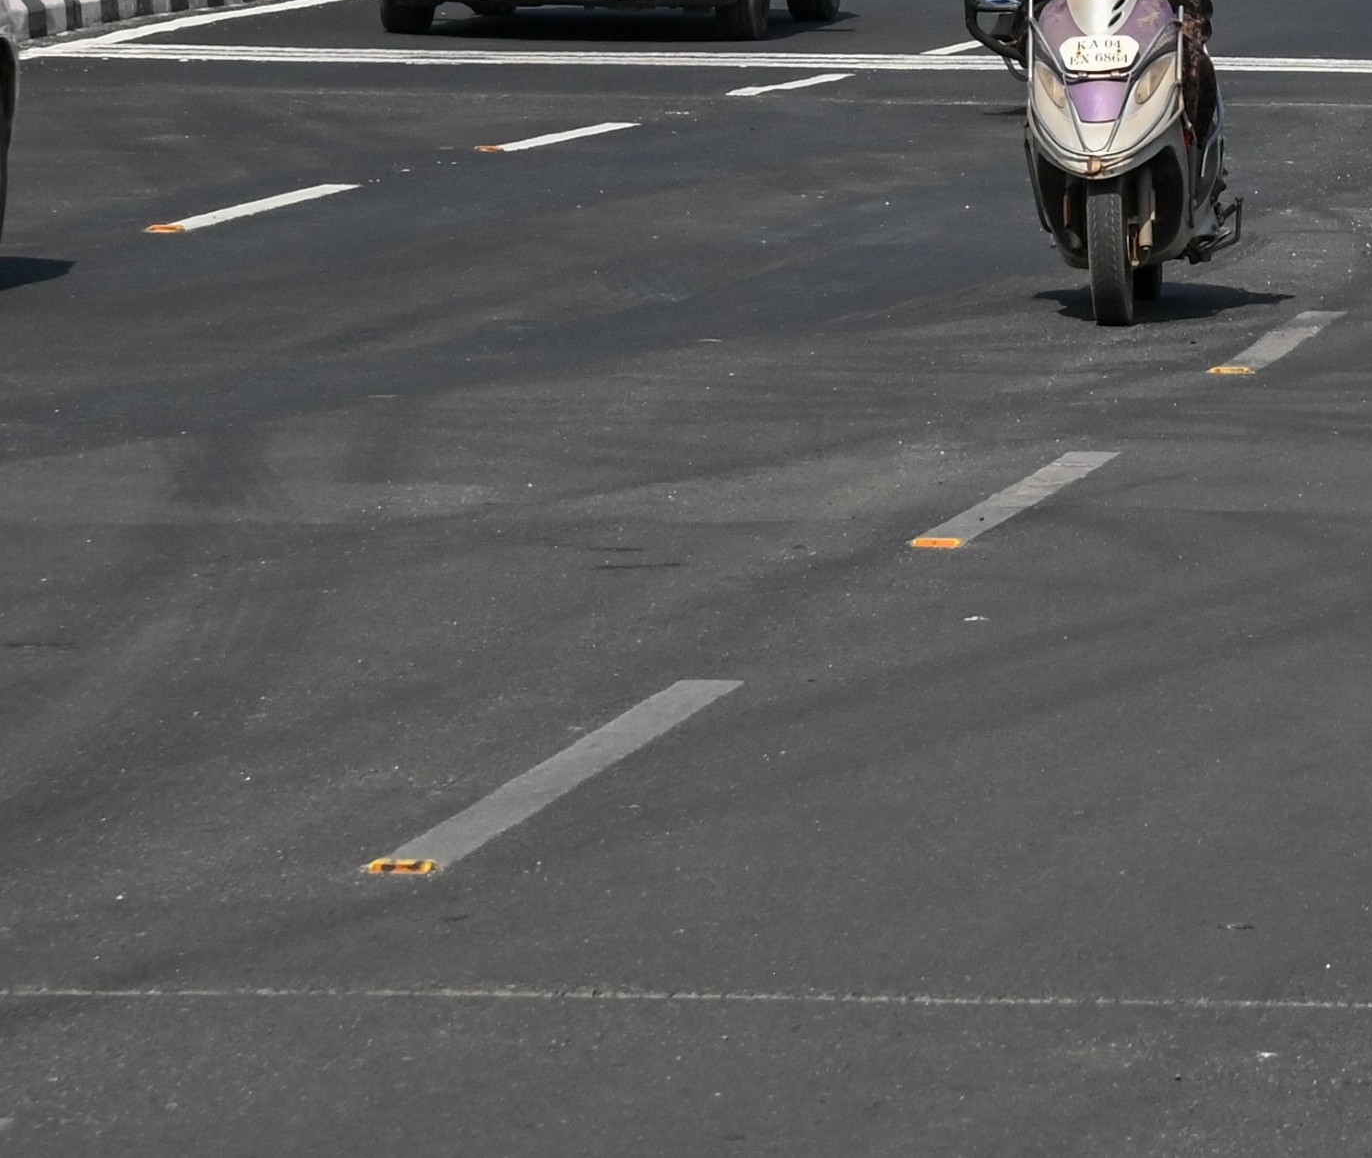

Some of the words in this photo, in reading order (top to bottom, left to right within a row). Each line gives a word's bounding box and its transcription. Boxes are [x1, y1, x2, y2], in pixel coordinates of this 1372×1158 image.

[1077, 40, 1099, 50] KA
[1104, 39, 1121, 49] 04
[1070, 54, 1089, 65] EX
